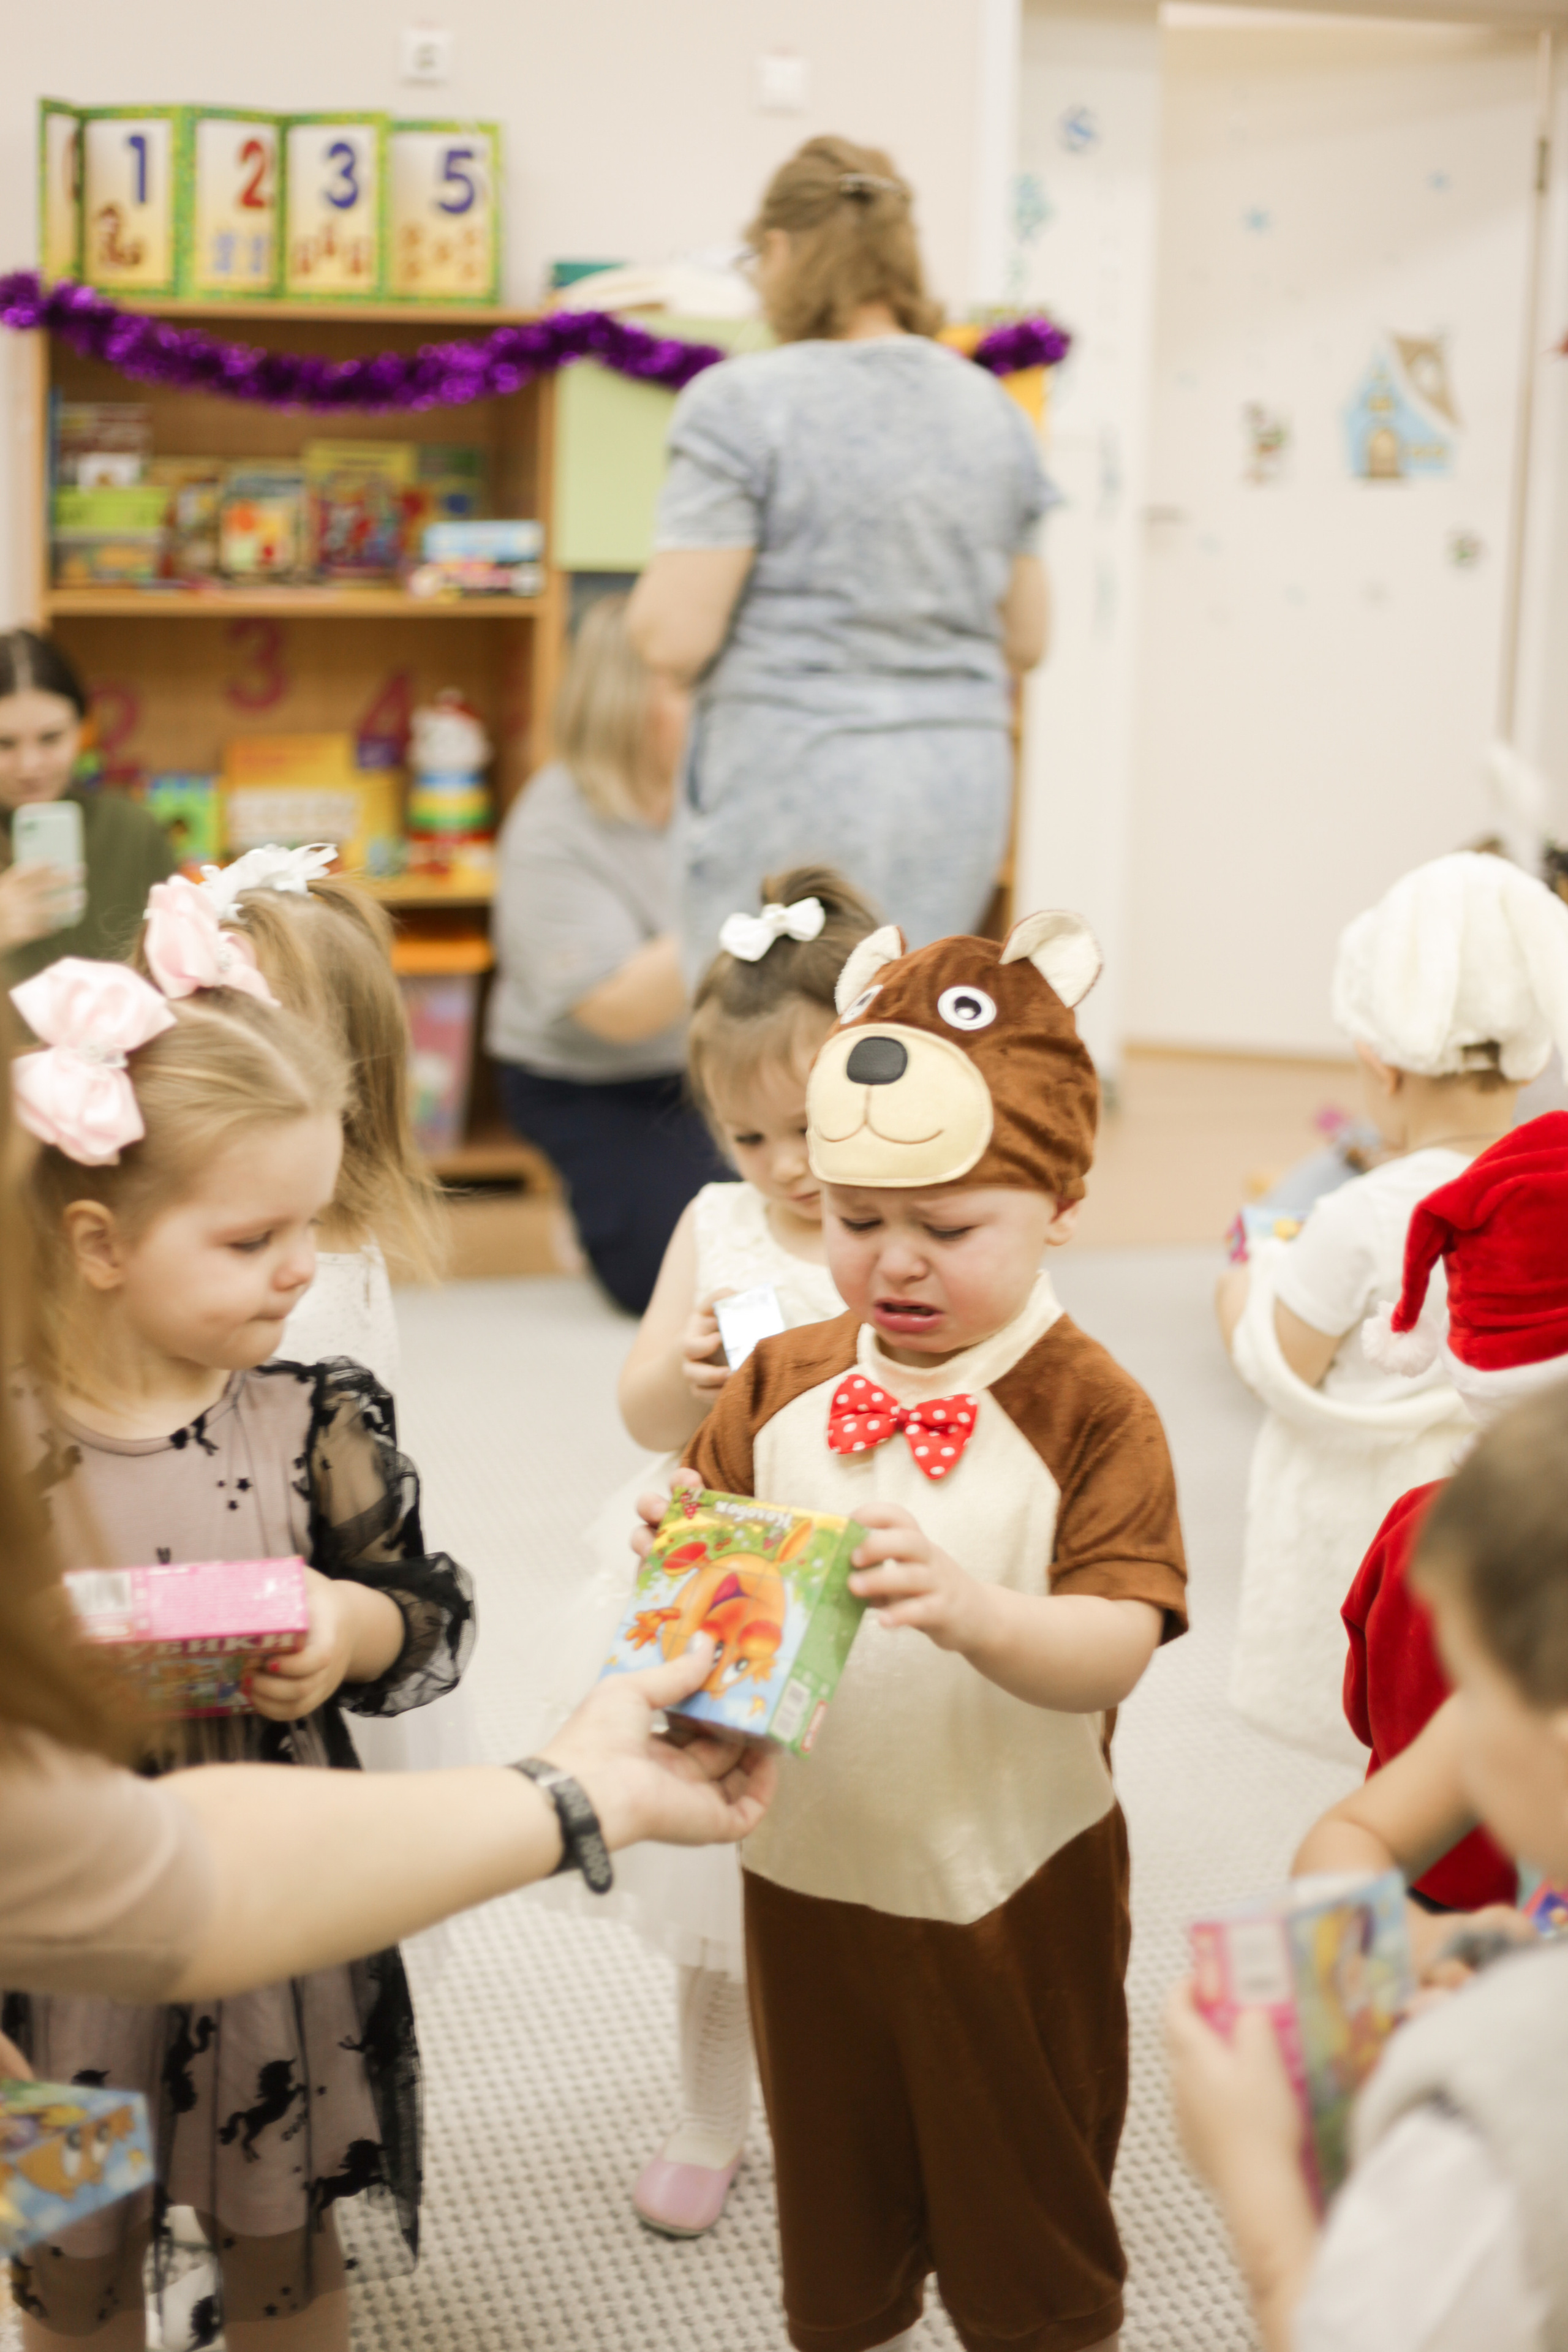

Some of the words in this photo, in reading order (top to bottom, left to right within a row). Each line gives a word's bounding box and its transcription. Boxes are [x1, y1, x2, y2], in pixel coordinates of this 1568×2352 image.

[128, 136, 147, 204] 1
[238, 139, 273, 209] 2
[325, 141, 359, 209] 3
[437, 148, 477, 214] 5
[225, 619, 287, 714] 3
[715, 1501, 793, 1529] Колобок
